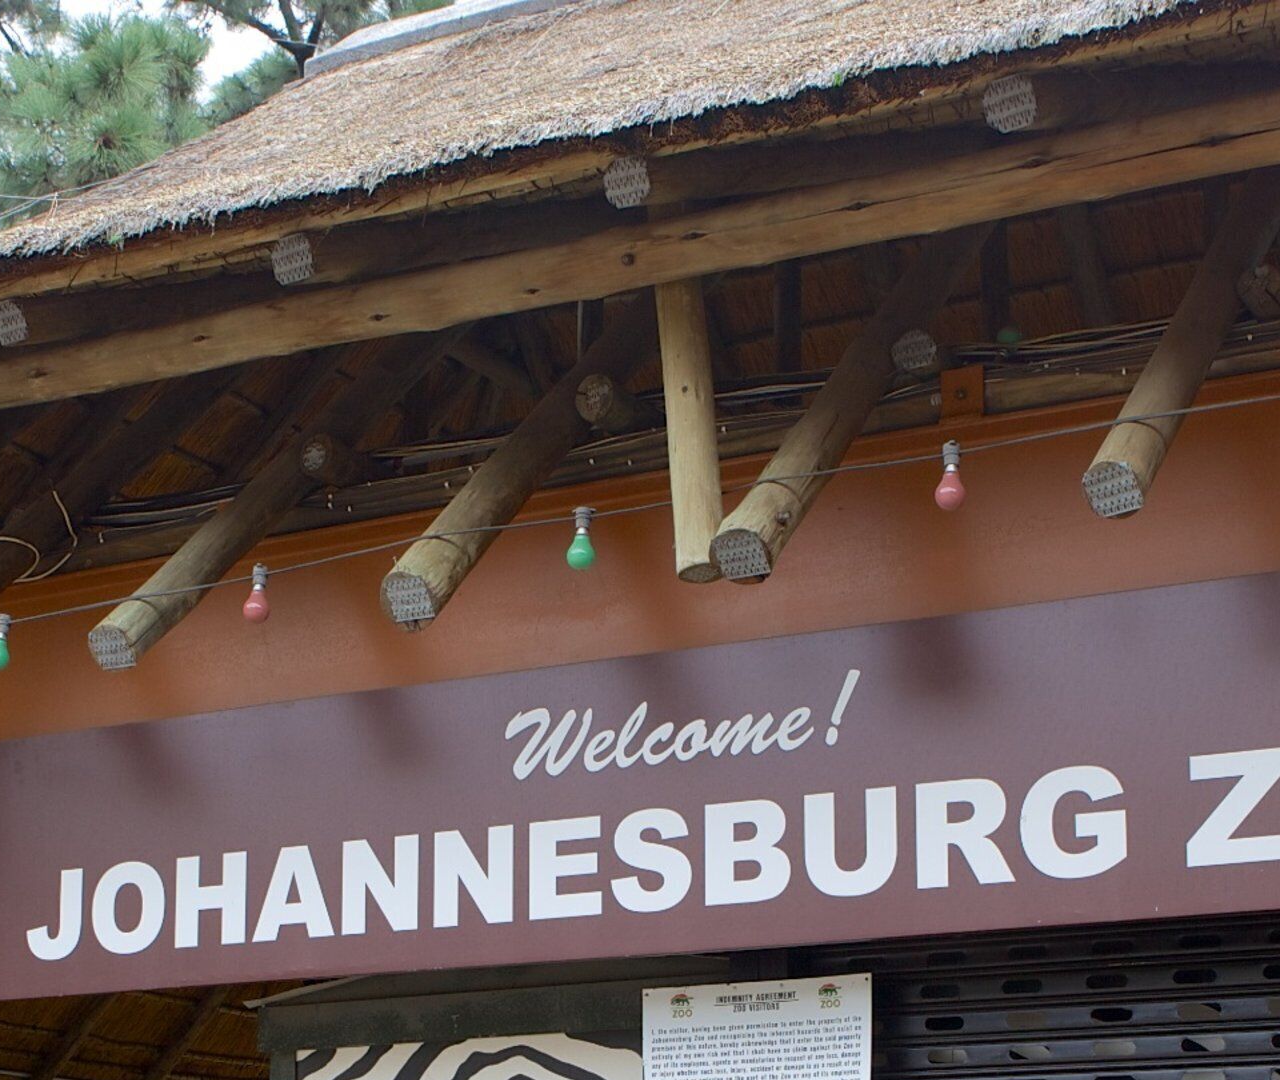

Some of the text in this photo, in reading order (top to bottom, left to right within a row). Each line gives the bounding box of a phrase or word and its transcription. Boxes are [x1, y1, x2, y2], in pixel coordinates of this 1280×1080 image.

[504, 670, 860, 781] Welcome!
[26, 765, 1128, 961] JOHANNESBURG
[715, 990, 798, 1004] INDEMNITY AGREEMENT
[732, 1002, 780, 1013] ZOO VISITORS
[819, 999, 841, 1009] ZOO
[671, 1009, 693, 1019] ZOO
